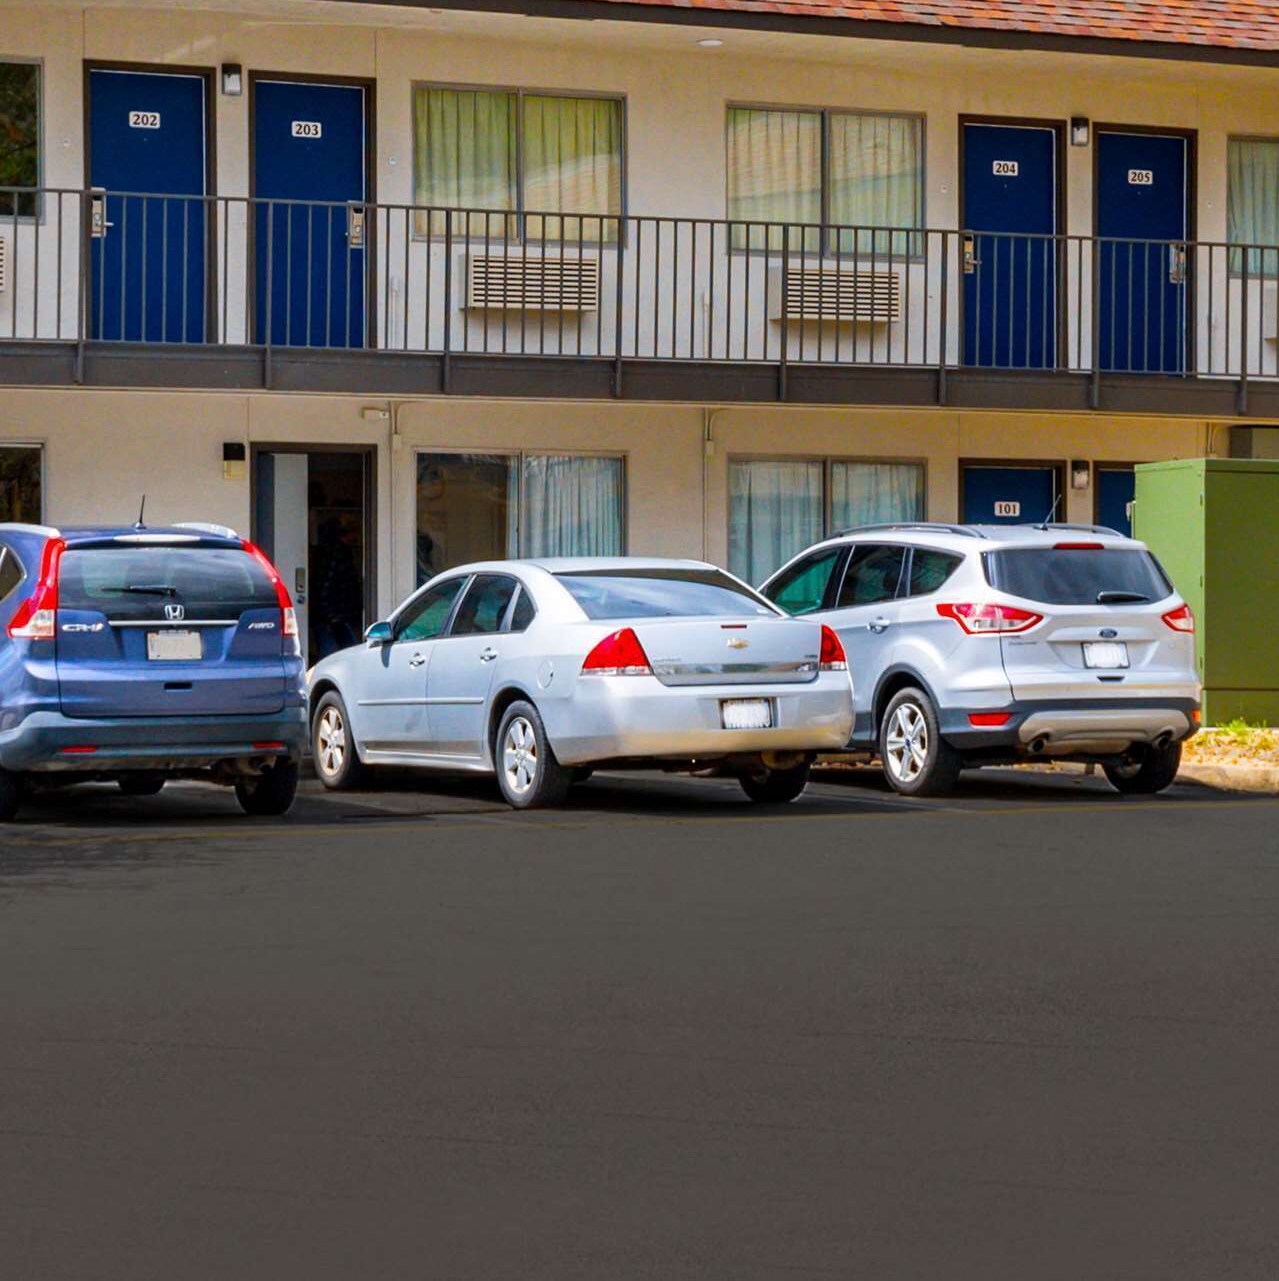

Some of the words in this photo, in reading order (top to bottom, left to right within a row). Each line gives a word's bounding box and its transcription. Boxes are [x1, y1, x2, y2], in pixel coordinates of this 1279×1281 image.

[132, 114, 158, 126] 202
[295, 123, 319, 136] 203
[995, 162, 1016, 174] 204
[1131, 171, 1151, 183] 205
[998, 503, 1017, 515] 101
